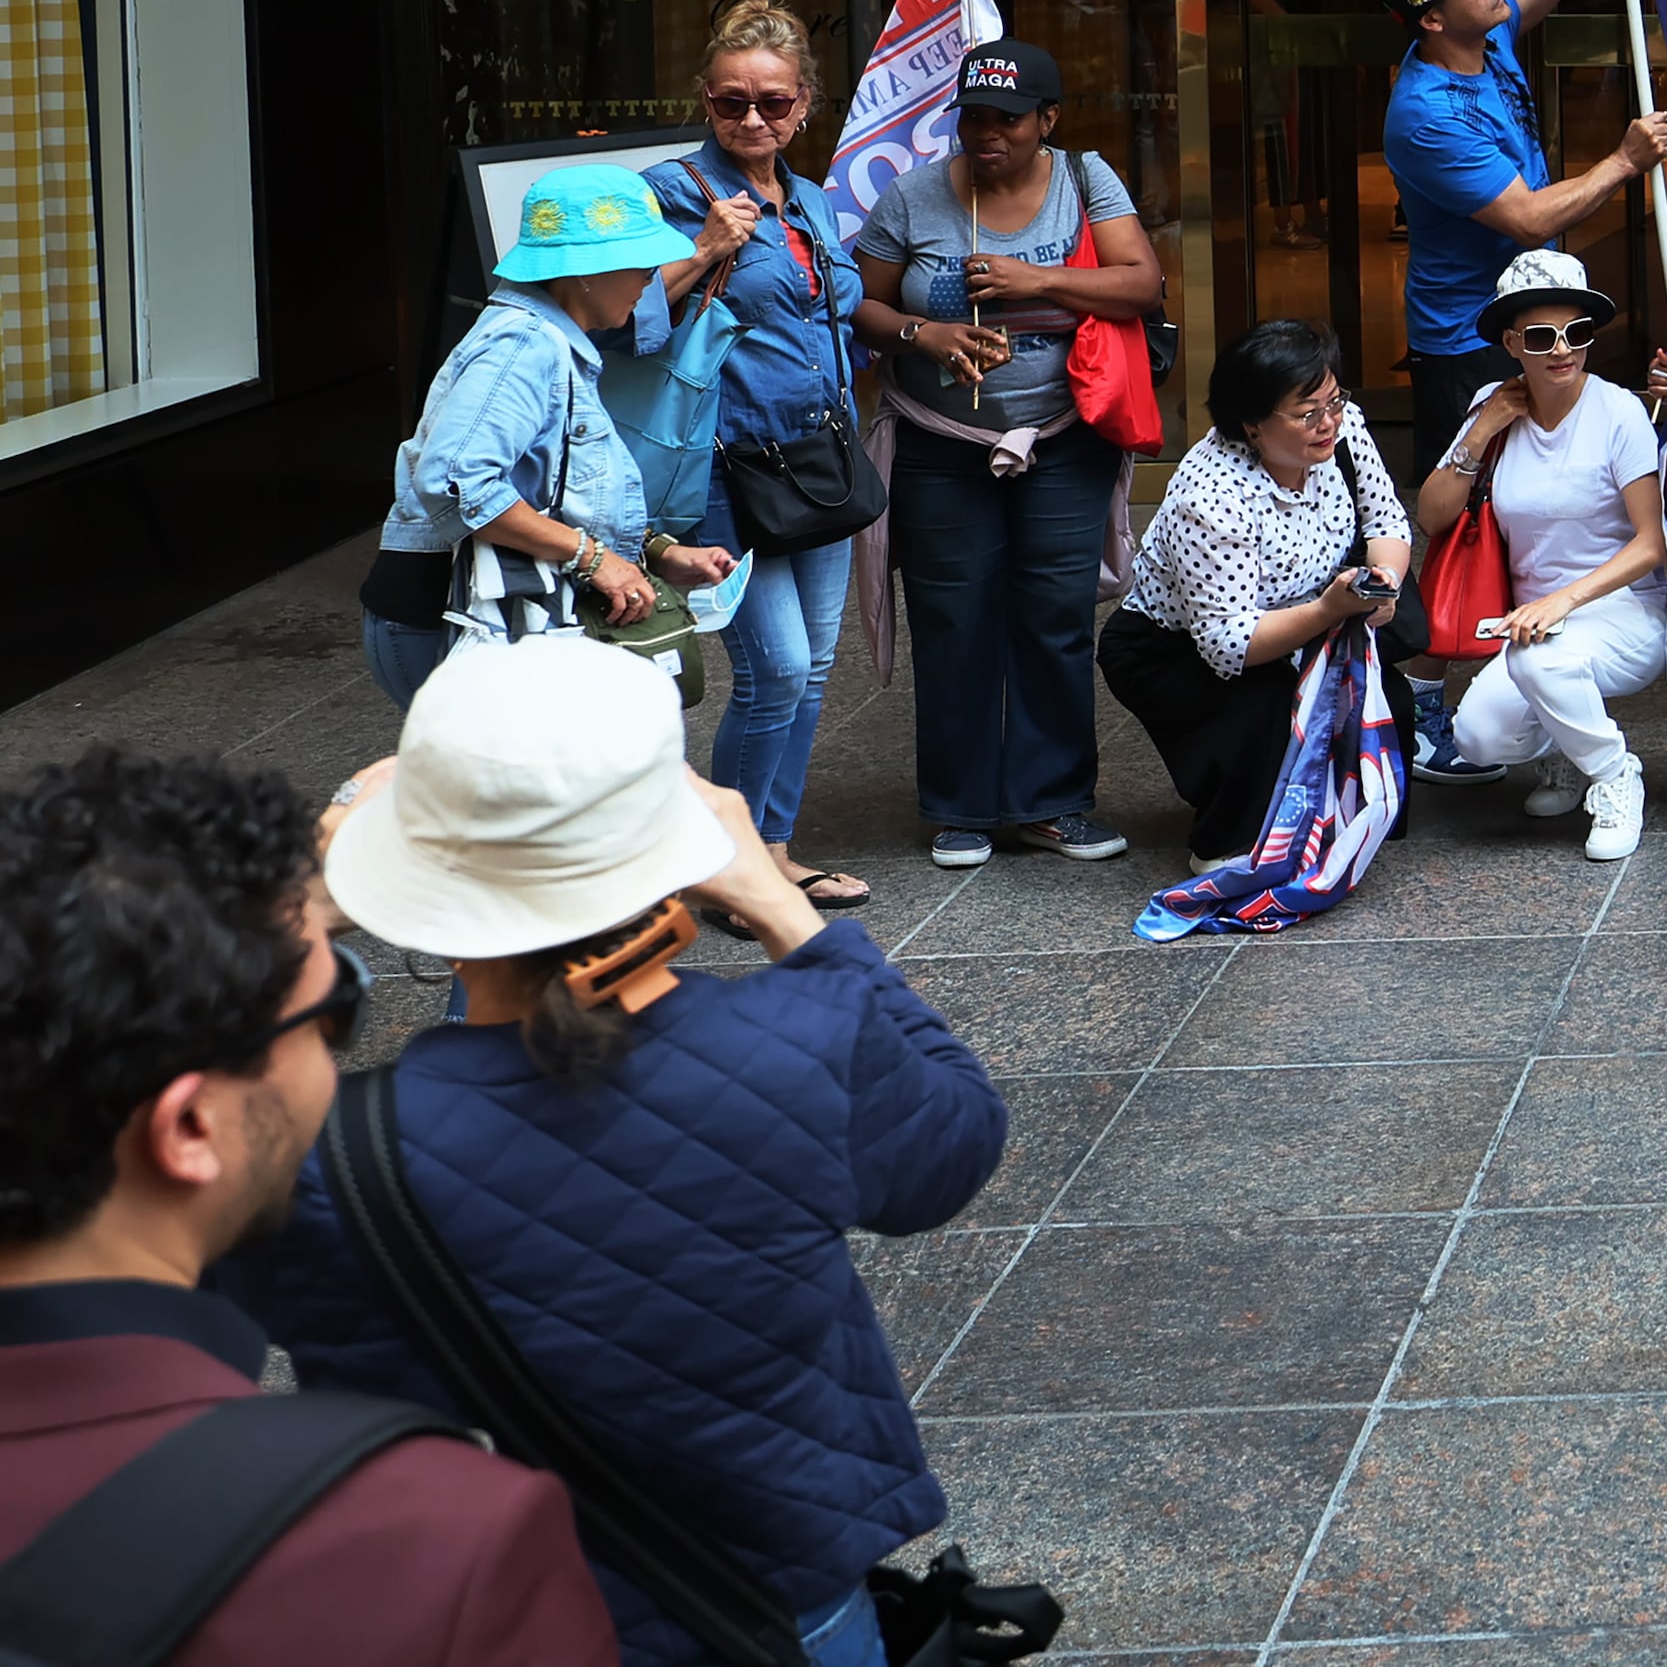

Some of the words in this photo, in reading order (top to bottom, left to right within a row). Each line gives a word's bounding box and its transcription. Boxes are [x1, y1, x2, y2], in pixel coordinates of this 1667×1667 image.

[968, 57, 1018, 72] ULTRA
[965, 73, 1016, 90] MAGA
[1034, 244, 1058, 264] BE
